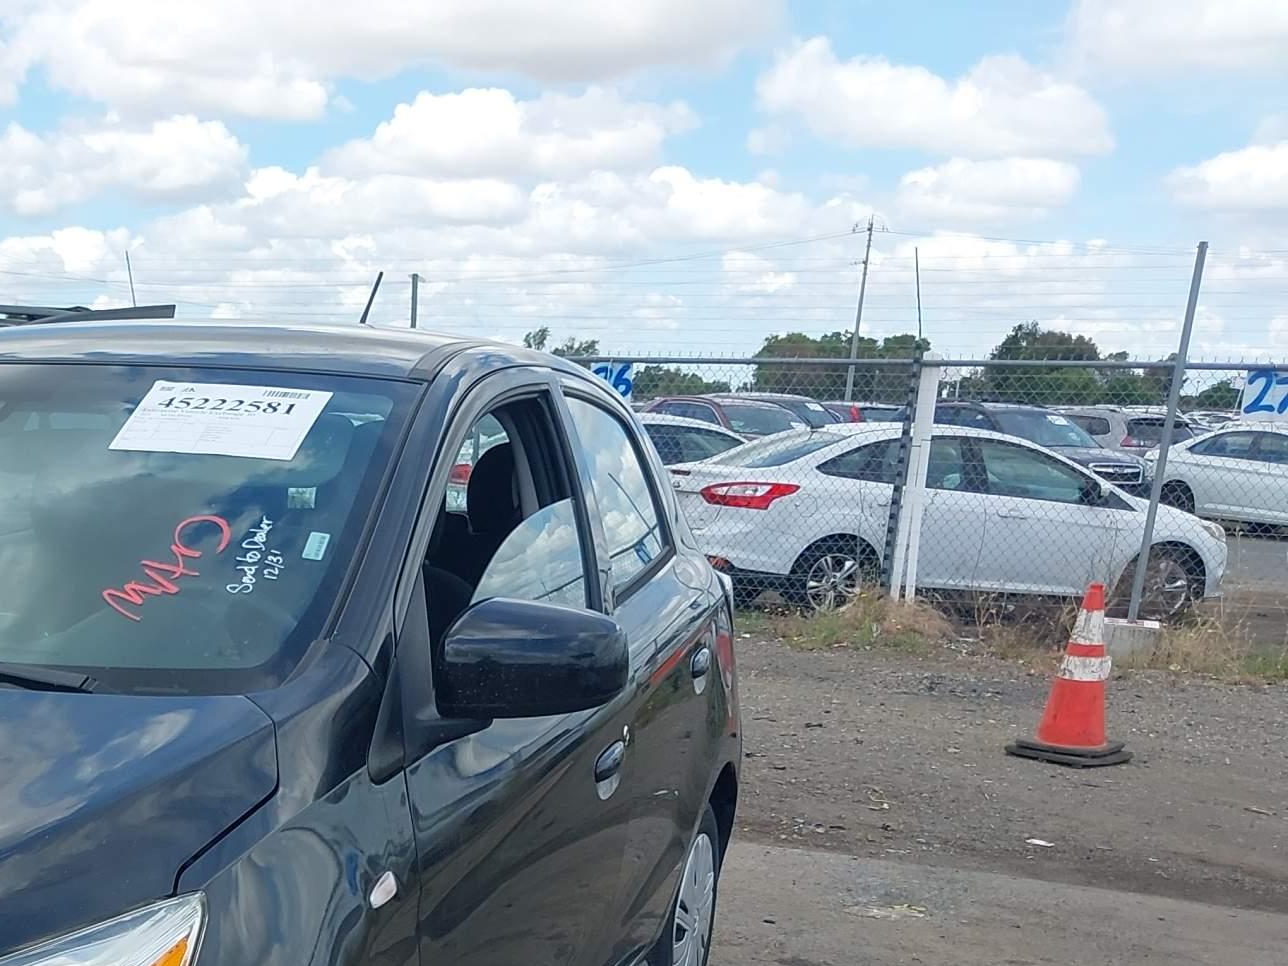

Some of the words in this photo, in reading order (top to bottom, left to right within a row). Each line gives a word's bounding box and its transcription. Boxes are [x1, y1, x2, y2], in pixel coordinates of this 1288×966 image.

[158, 396, 296, 416] 45222581
[241, 515, 273, 551] Dealer
[236, 551, 261, 563] to
[263, 549, 285, 579] 12/31
[226, 566, 259, 593] Send
